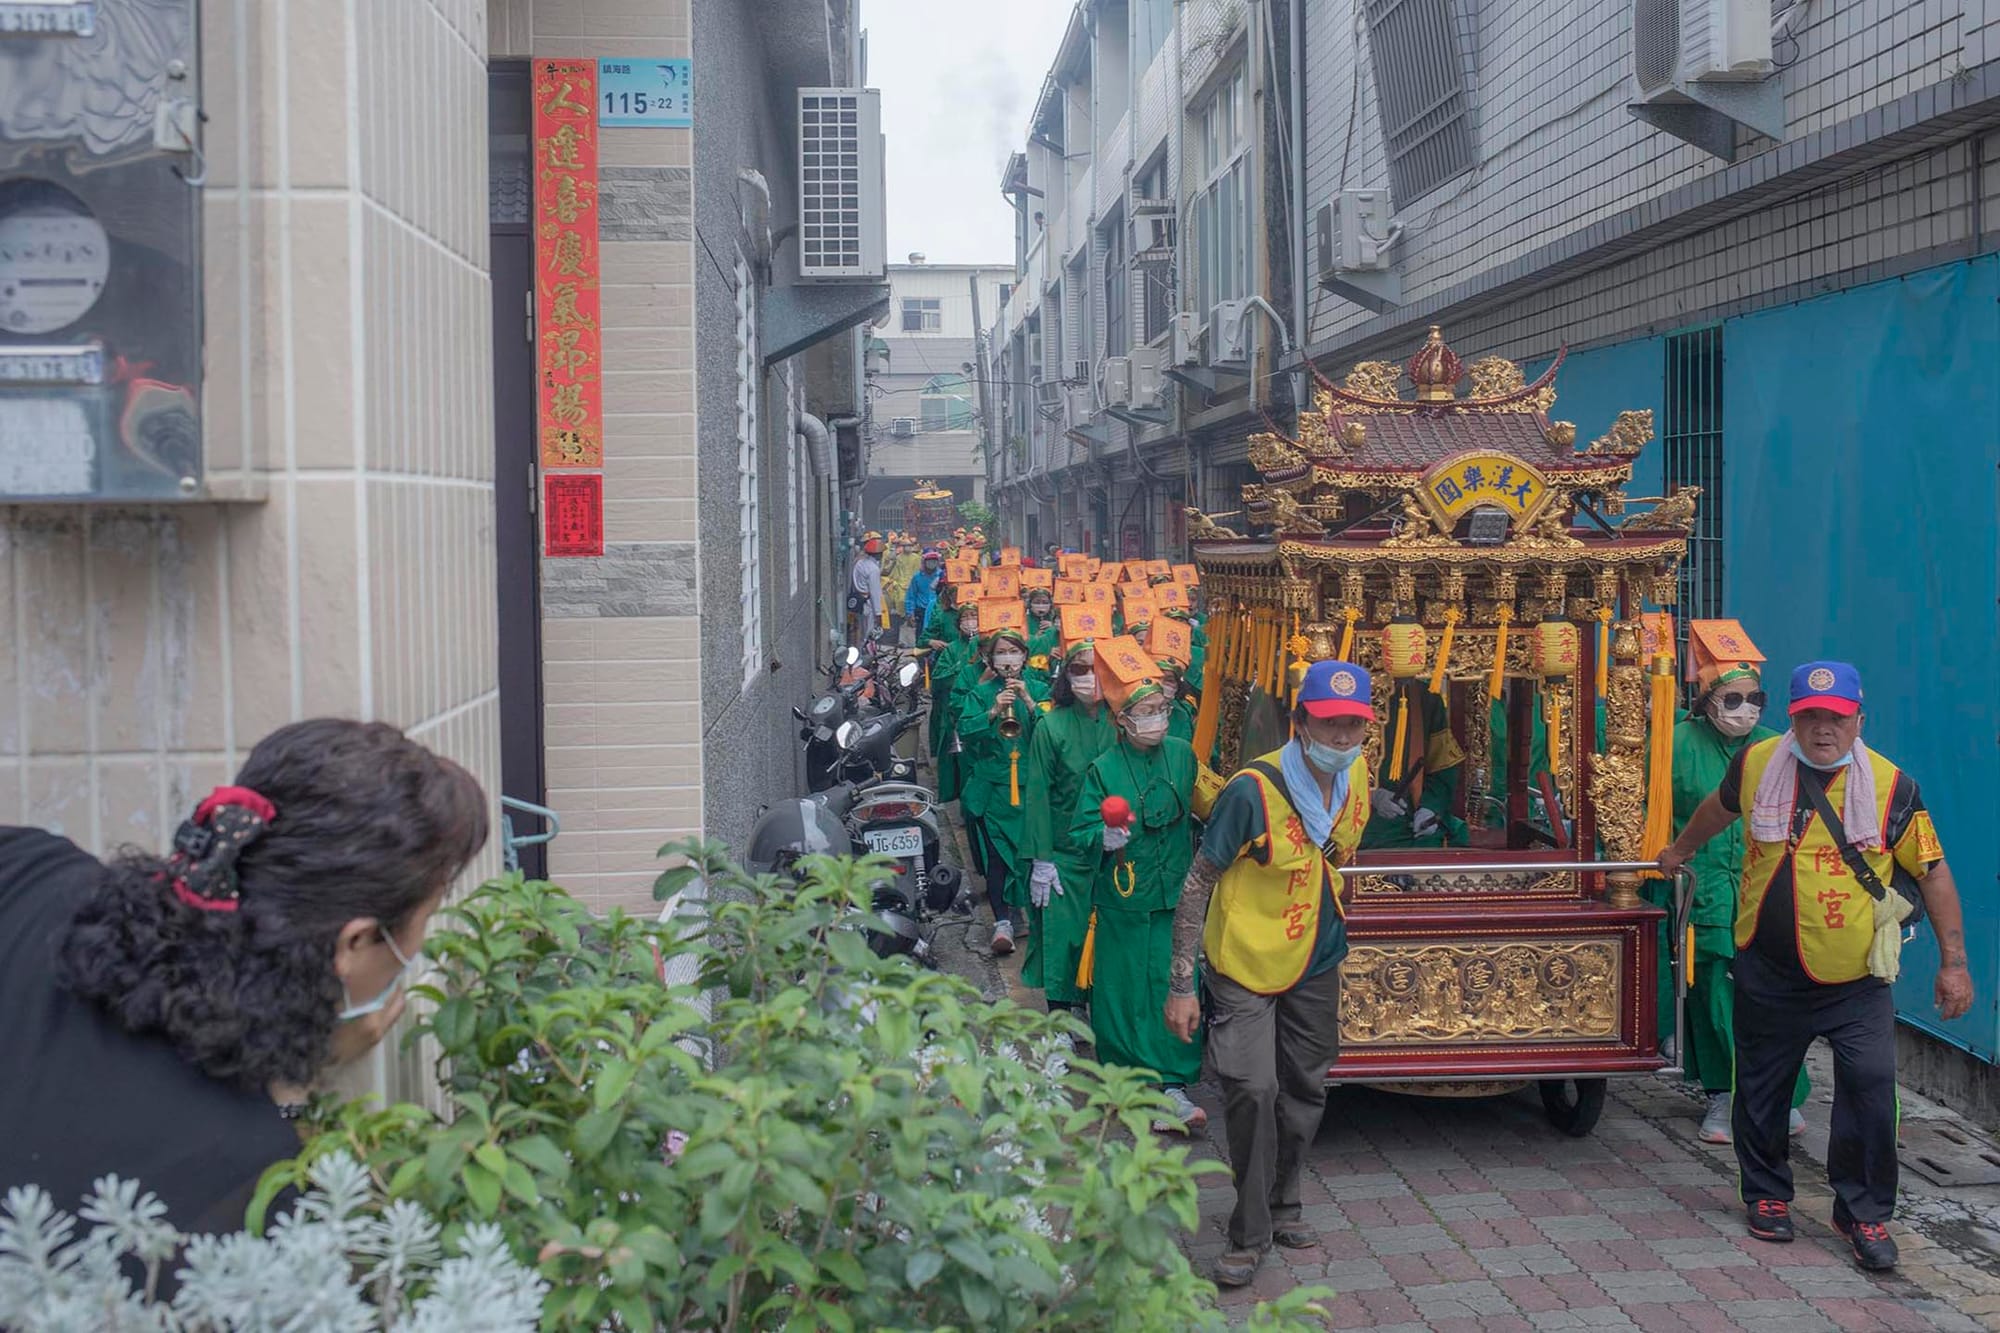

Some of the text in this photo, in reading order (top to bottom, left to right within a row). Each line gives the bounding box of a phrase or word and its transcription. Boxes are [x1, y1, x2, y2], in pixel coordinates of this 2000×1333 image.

[1435, 465, 1532, 508] 大漢樂團
[1814, 807, 1851, 929] 隆宮
